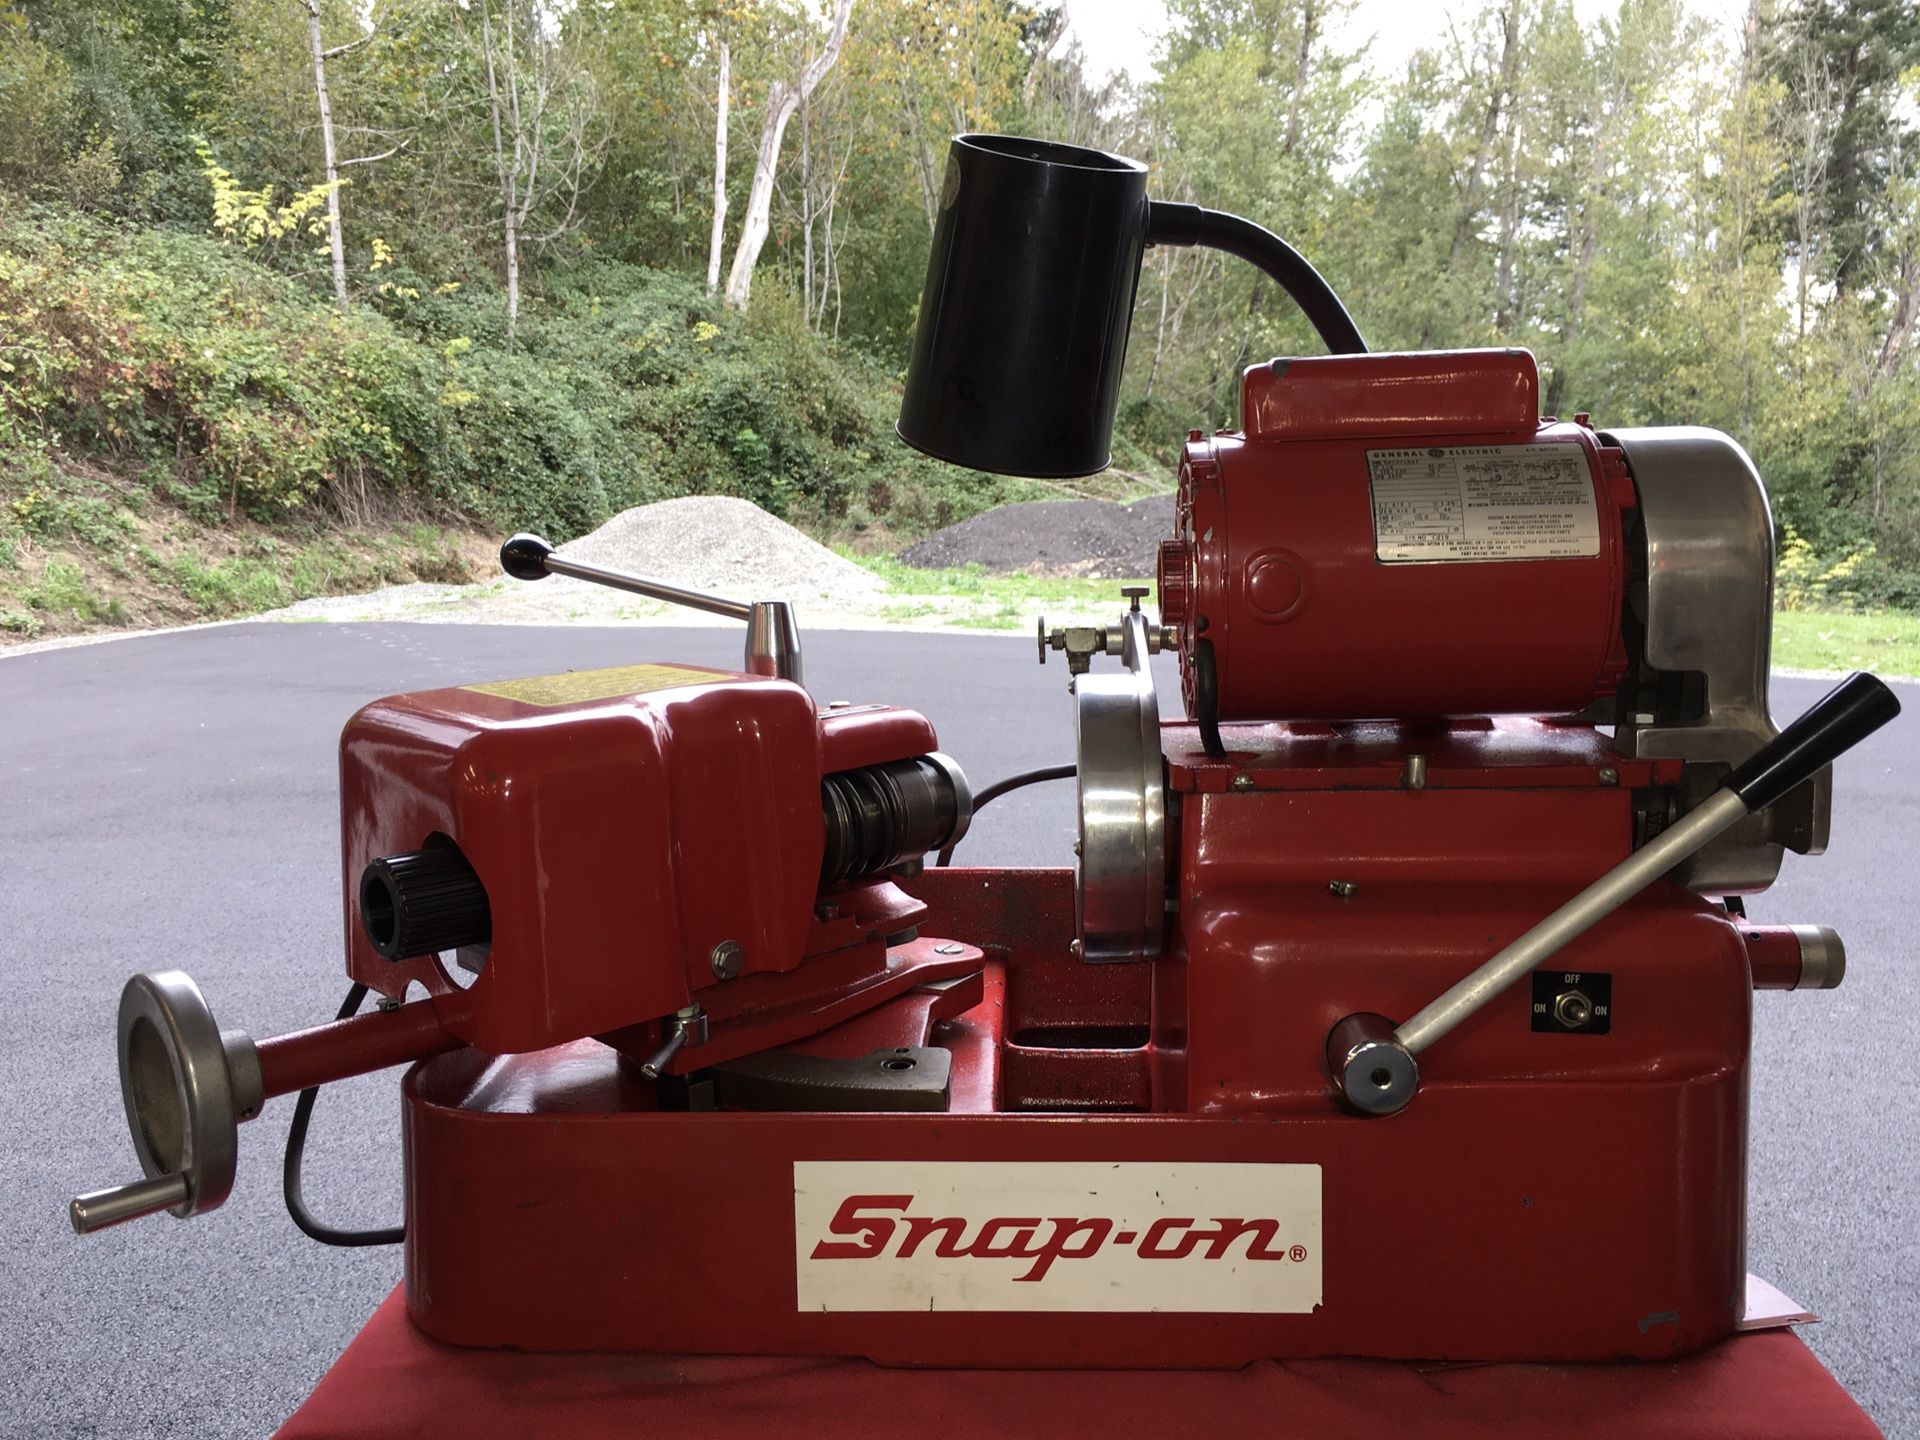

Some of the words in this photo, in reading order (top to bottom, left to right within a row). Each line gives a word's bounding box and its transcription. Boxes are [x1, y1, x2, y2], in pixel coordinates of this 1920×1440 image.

[1449, 448, 1502, 456] ELECTRIC
[1564, 974, 1581, 984] OFF
[1534, 1003, 1546, 1013] ON
[1594, 1006, 1607, 1016] ON
